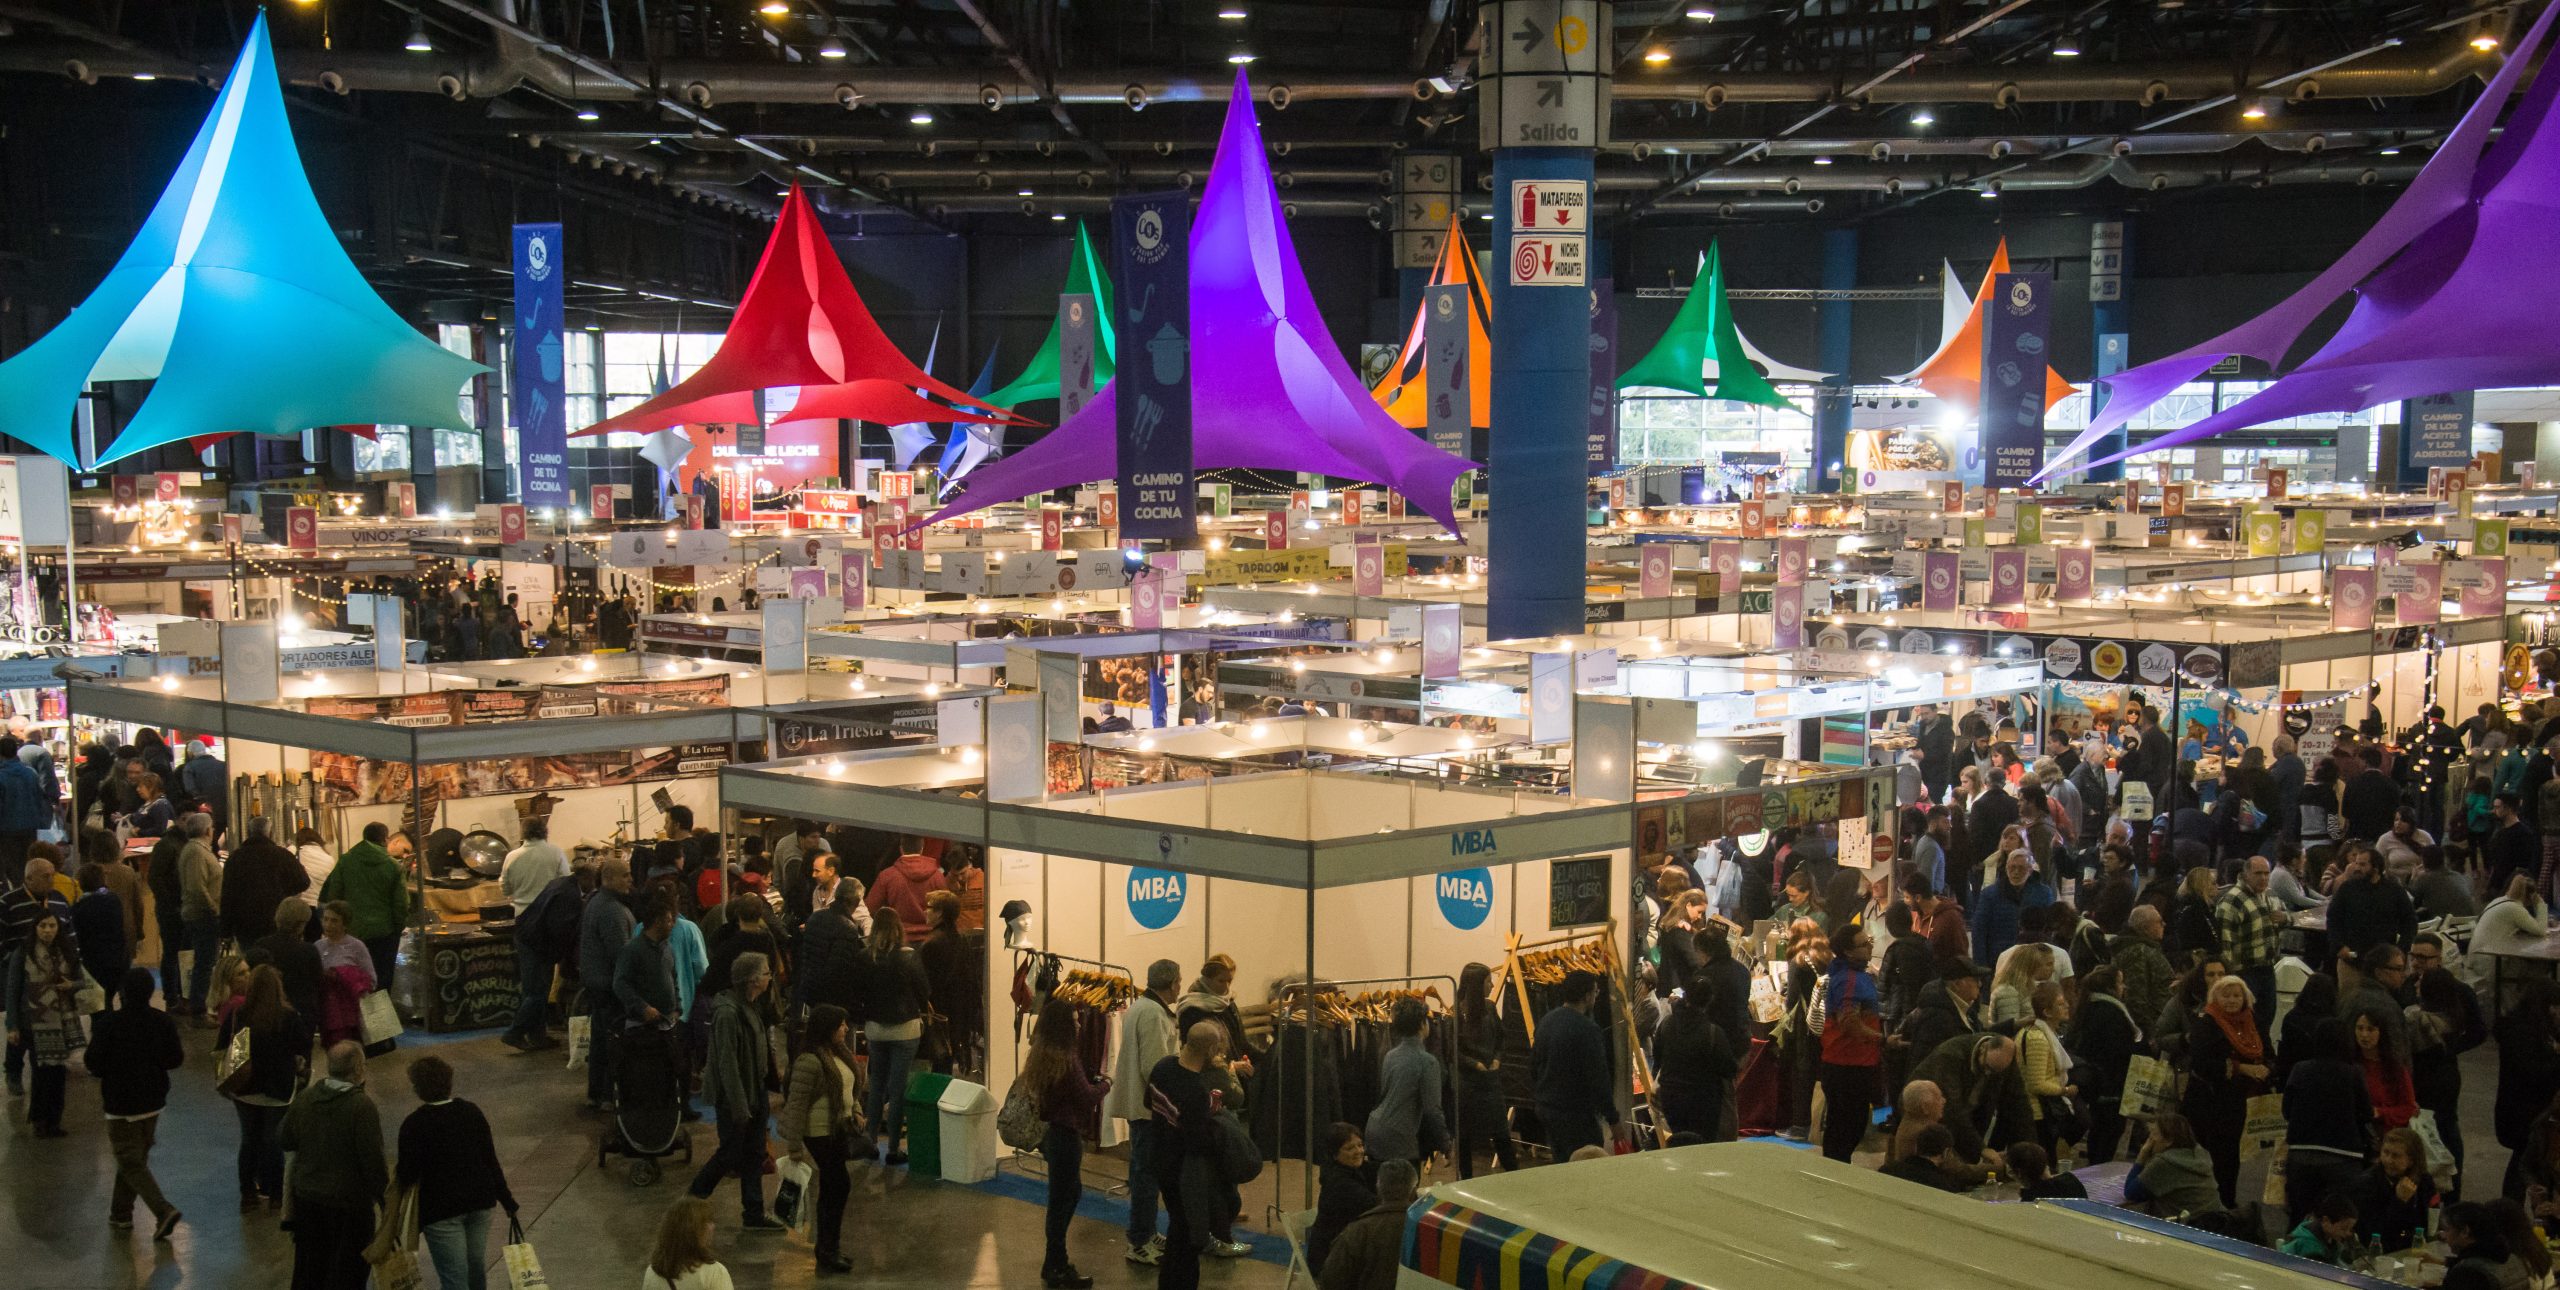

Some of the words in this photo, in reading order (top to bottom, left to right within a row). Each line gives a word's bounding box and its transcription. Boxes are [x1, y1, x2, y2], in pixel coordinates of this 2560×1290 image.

[1520, 124, 1578, 141] Salida
[1541, 192, 1583, 207] MATAFUEGOS
[1561, 243, 1579, 257] NICHOS
[1555, 262, 1581, 277] HIDRANTES
[2422, 413, 2463, 421] CAMINO
[2425, 422, 2438, 430] DE
[2439, 422, 2458, 430] LOS
[1434, 432, 1463, 440] CAMINO
[2422, 432, 2461, 440] ACEITES
[1446, 441, 1461, 449] LAS
[2427, 441, 2434, 449] Y
[2436, 441, 2456, 449] LOS
[778, 445, 820, 457] LECHE
[1996, 447, 2035, 456] CAMINO
[2414, 450, 2467, 458] ADEREZOS
[529, 453, 562, 464] CAMINO
[1998, 457, 2011, 466] DE
[2012, 458, 2031, 467] LOS
[534, 467, 545, 478] DE
[545, 467, 557, 478] TU
[1996, 468, 2032, 477] DULCES
[1132, 473, 1184, 486] CAMINO
[530, 481, 562, 492] COCINA
[1140, 490, 1156, 502] DE
[1158, 490, 1176, 502] TU
[1134, 506, 1183, 519] COCINA
[352, 530, 396, 542] VINOS
[1237, 562, 1289, 574] TAPROOM
[1274, 627, 1310, 639] URUGUAY
[345, 659, 375, 667] VERDUR
[807, 726, 828, 743] La
[832, 723, 884, 742] Triesta
[691, 746, 701, 754] La
[702, 745, 725, 753] Triesta
[1451, 829, 1497, 856] MBA
[1131, 875, 1182, 903] MBA
[1440, 876, 1488, 903] MBA
